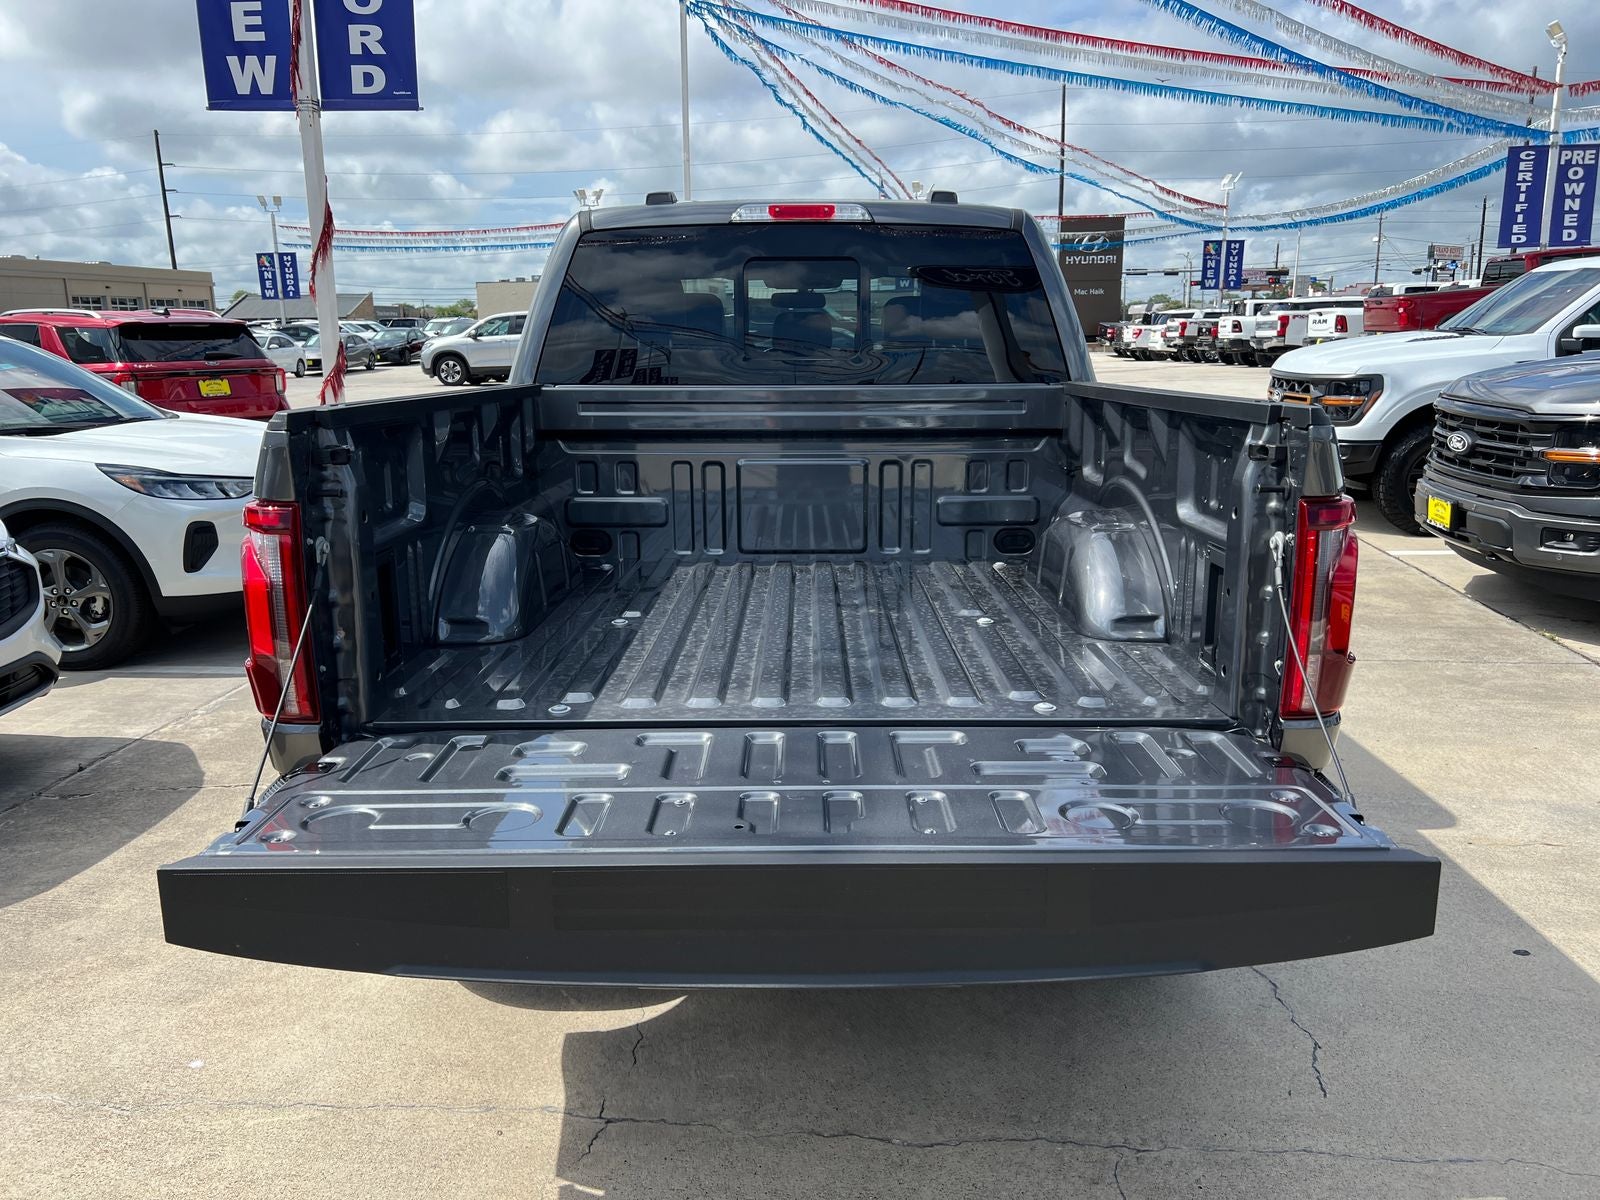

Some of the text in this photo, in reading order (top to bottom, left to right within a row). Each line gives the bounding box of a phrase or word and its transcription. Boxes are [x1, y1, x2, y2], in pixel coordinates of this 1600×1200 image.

[1560, 149, 1597, 165] PRE
[1511, 150, 1536, 243] CERTIFIED
[1562, 166, 1585, 242] OWNED
[283, 255, 295, 297] HYUNDAI
[1065, 255, 1117, 265] HYUNDAI
[1204, 260, 1216, 288] NEW
[1228, 243, 1240, 287] HYUNDAI
[264, 271, 275, 298] NEW
